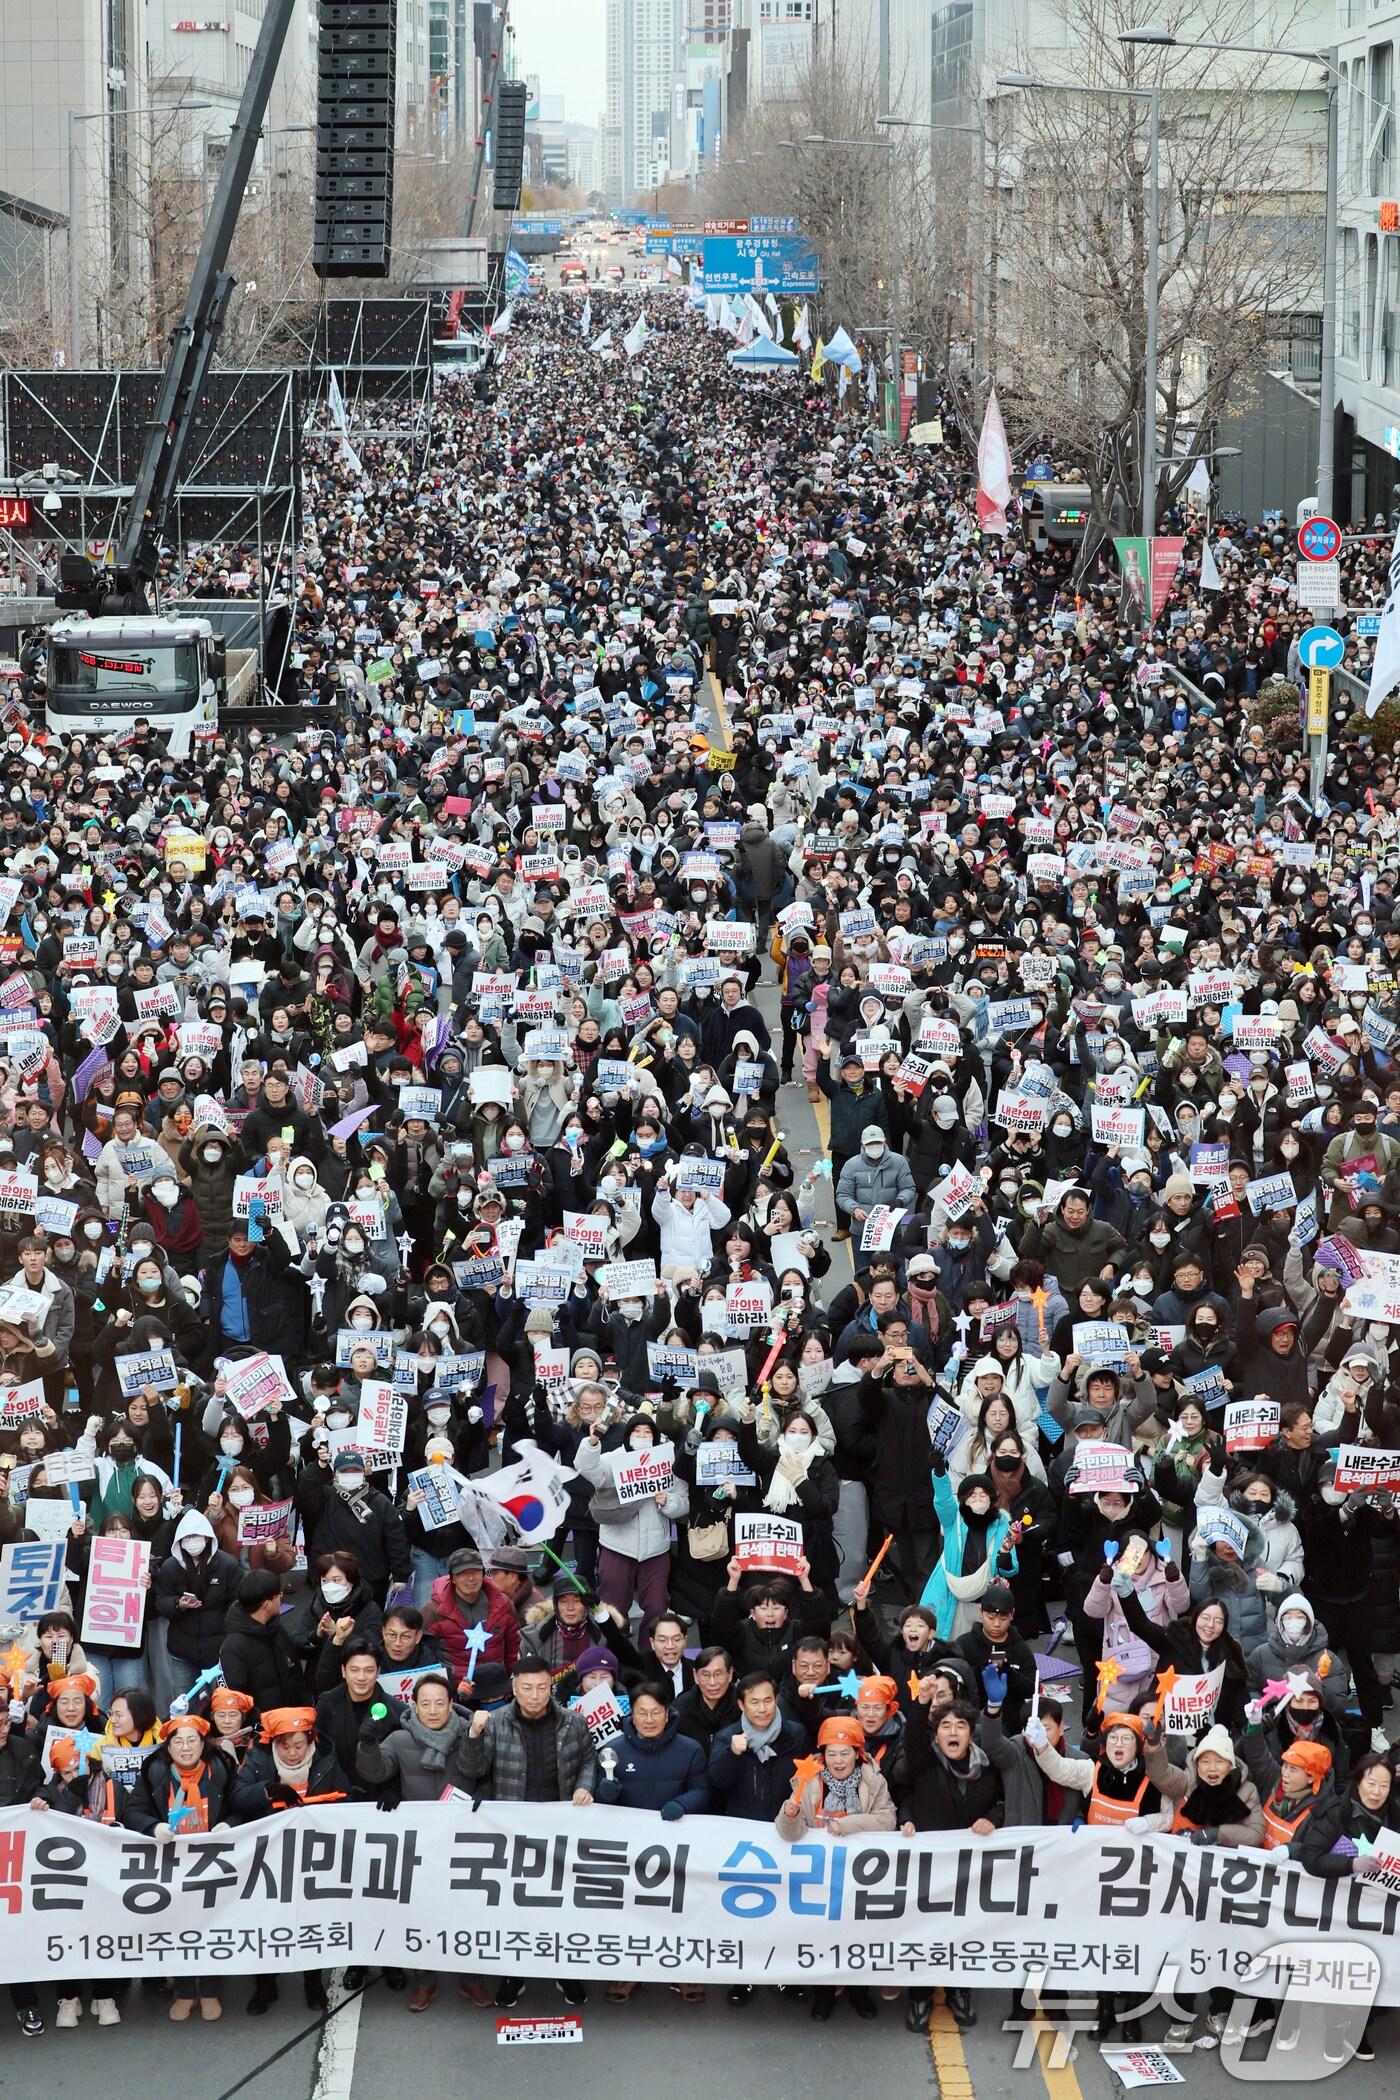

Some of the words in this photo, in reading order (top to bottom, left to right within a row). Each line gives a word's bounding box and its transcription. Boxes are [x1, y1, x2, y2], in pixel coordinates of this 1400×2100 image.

[176, 22, 198, 31] ABL
[737, 249, 757, 257] 시청
[782, 271, 816, 280] 고속도로
[1304, 534, 1336, 544] 주정차금지
[90, 702, 154, 710] DAEWOO
[525, 858, 555, 869] 내란수괴
[411, 871, 444, 881] 내란의힘
[712, 930, 747, 940] 내란의힘
[66, 939, 96, 953] 내란수괴
[874, 974, 911, 985] 내란의힘
[474, 983, 512, 994] 내란의힘
[1194, 982, 1231, 995] 내란의힘
[139, 994, 174, 1010] 내란의힘
[515, 1000, 554, 1012] 내란의힘
[922, 1030, 960, 1044] 내란의힘
[1237, 1028, 1276, 1039] 내란의힘
[917, 1040, 963, 1054] 해체하라!
[1001, 1105, 1043, 1120] 내란의힘
[1097, 1119, 1138, 1133] 내란의힘
[682, 1173, 721, 1187] 탄핵체포
[526, 1273, 561, 1287] 윤석열
[520, 1286, 566, 1299] 탄핵체포
[1083, 1325, 1123, 1341] 윤석열
[1078, 1338, 1130, 1353] 탄핵체포
[126, 1356, 164, 1374] 윤석열
[446, 1355, 479, 1374] 윤석열
[655, 1352, 690, 1366] 윤석열
[124, 1367, 173, 1390] 탄핵체포
[439, 1366, 480, 1386] 탄핵체포
[652, 1364, 697, 1379] 탄핵체포
[230, 1363, 274, 1398] 국민의힘
[373, 1387, 393, 1443] 내란의힘
[1229, 1405, 1280, 1427] 내란수괴
[1226, 1425, 1260, 1442] 윤석열
[619, 1460, 672, 1484] 내란의힘
[1339, 1469, 1376, 1485] 윤석열
[619, 1474, 675, 1499] 해체하라!
[243, 1505, 290, 1525] 국민의힘
[741, 1522, 797, 1543] 내란수괴
[738, 1541, 775, 1560] 윤석열
[775, 1544, 802, 1560] 탄핵!
[6, 1542, 64, 1622] 퇴진
[88, 1539, 147, 1644] 탄핵
[119, 1827, 422, 1914] 광주시민과
[448, 1831, 691, 1914] 국민들의
[716, 1840, 1059, 1922] 승리입니다.
[45, 1921, 355, 1963] 5·18민주유공자유족회
[403, 1926, 745, 1970] 5·18민주화운동부상자회
[796, 1938, 1141, 1976] 5·18민주화운동공로자회
[1188, 1944, 1382, 1992] 5·18기념재단
